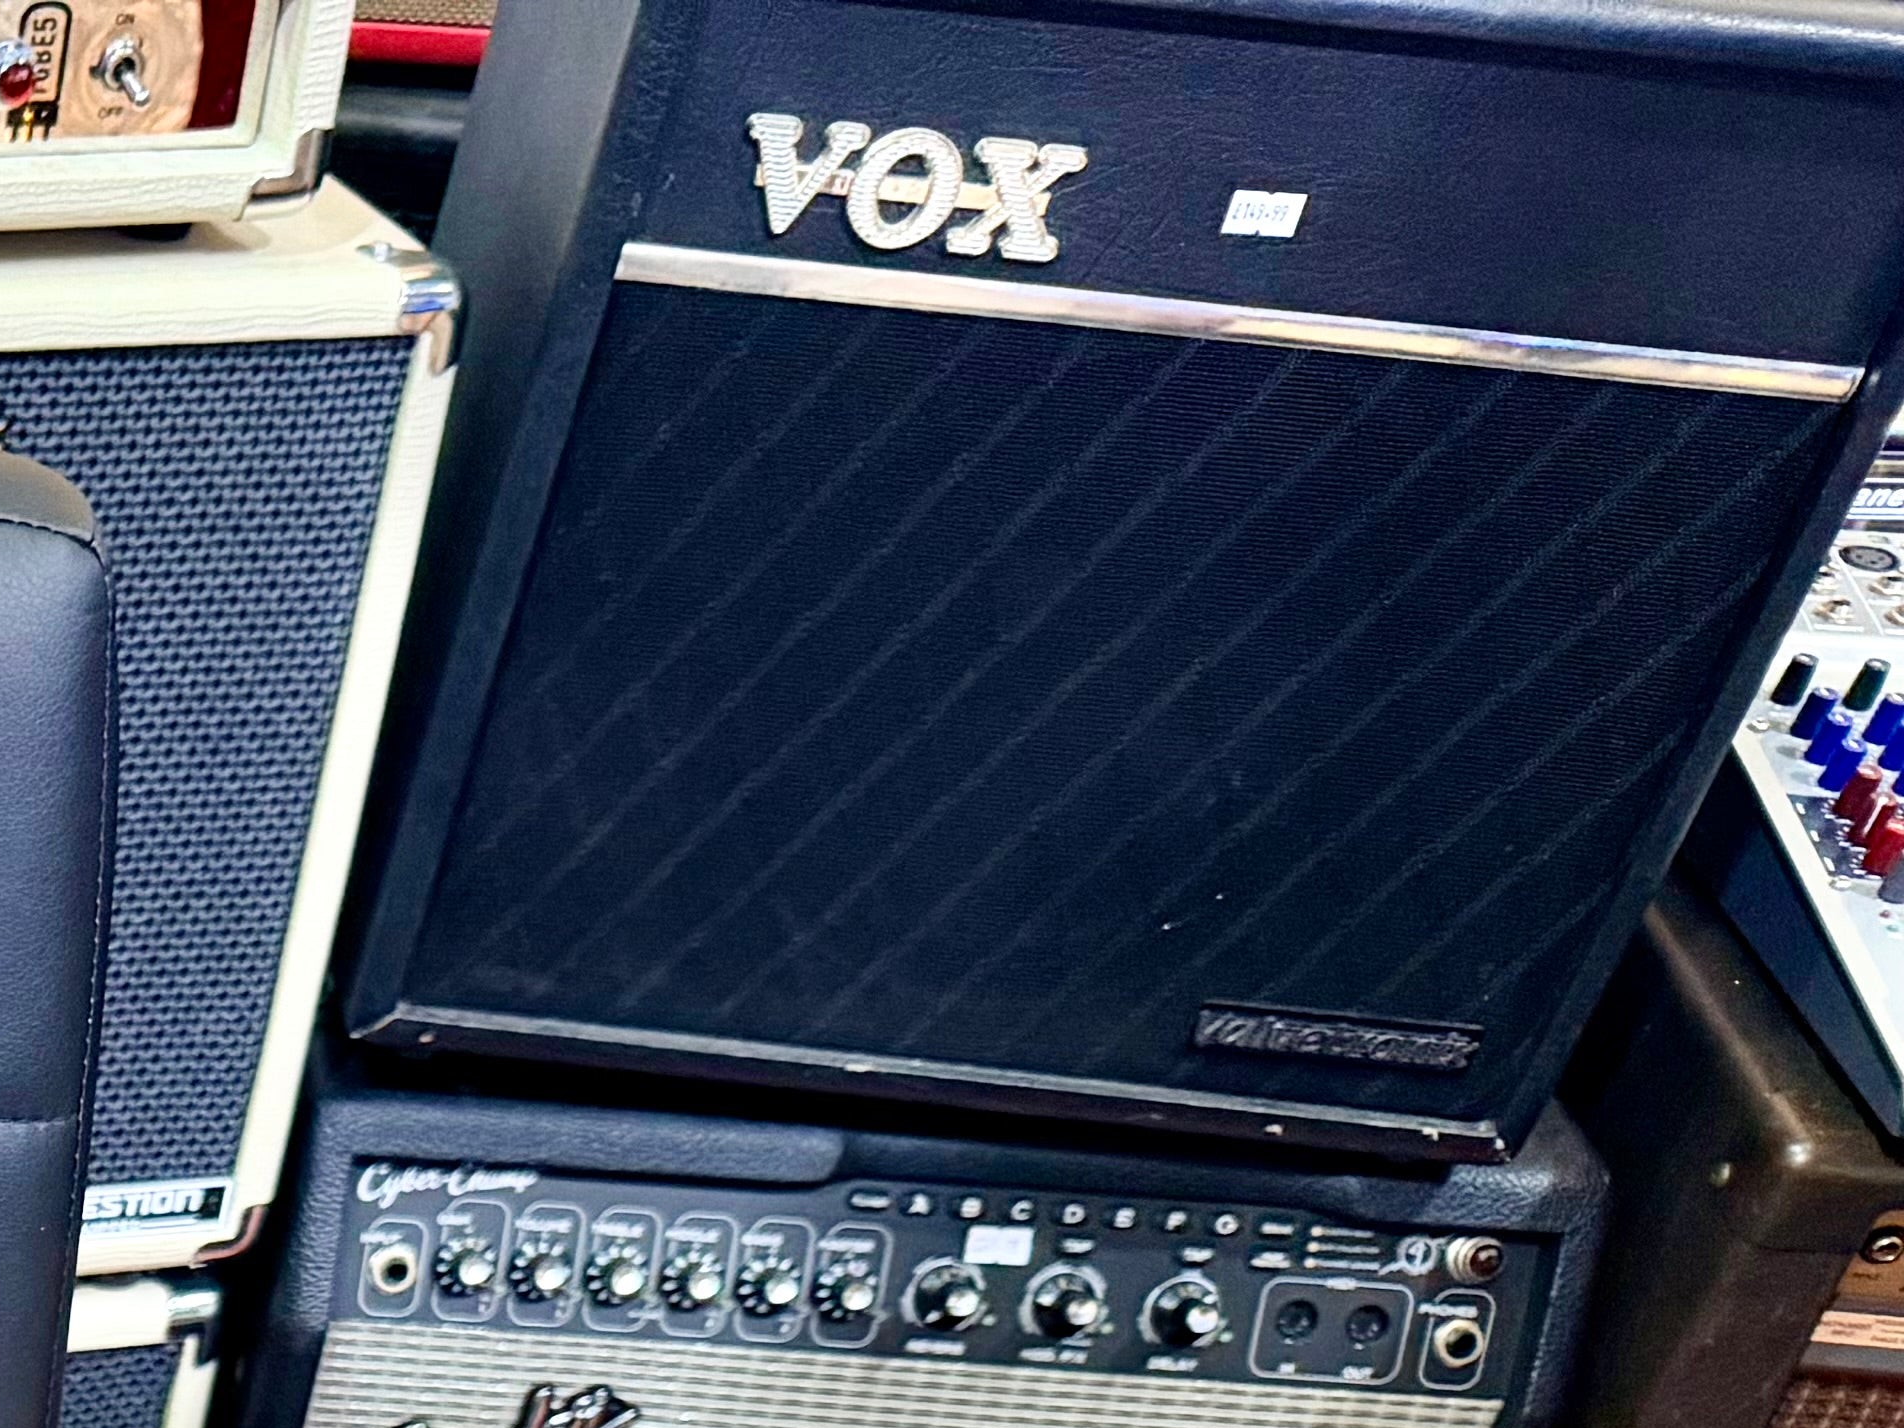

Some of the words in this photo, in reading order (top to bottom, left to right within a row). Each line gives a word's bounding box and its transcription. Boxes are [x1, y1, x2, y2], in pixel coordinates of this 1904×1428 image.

[748, 111, 1087, 262] VOX
[1853, 488, 1904, 510] ane
[84, 1189, 206, 1221] ESTION
